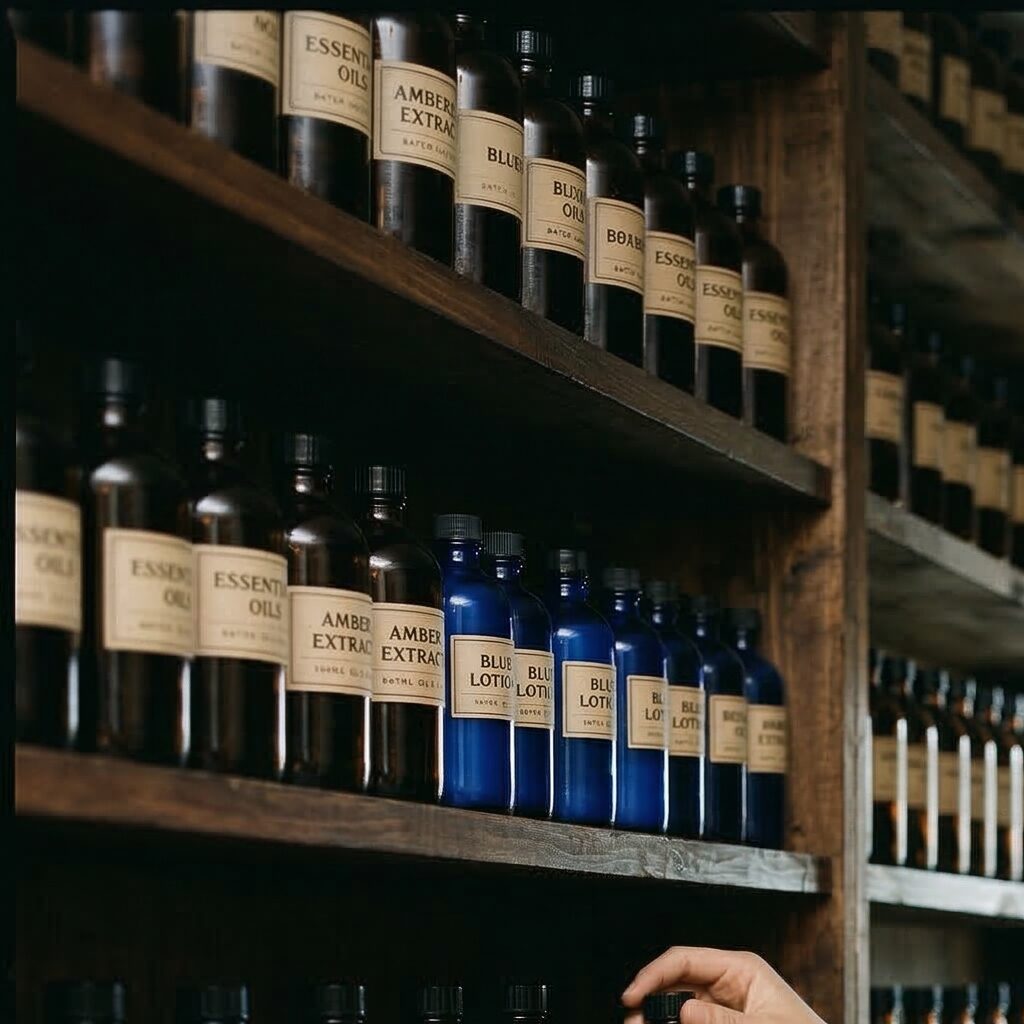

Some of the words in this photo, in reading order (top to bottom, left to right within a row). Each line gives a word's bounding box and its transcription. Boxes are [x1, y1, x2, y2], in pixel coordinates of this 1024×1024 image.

[338, 64, 369, 91] OILS
[248, 599, 283, 621] OILS
[380, 645, 444, 668] EXTRAC
[470, 672, 515, 690] LOTIO
[528, 665, 553, 683] BLU
